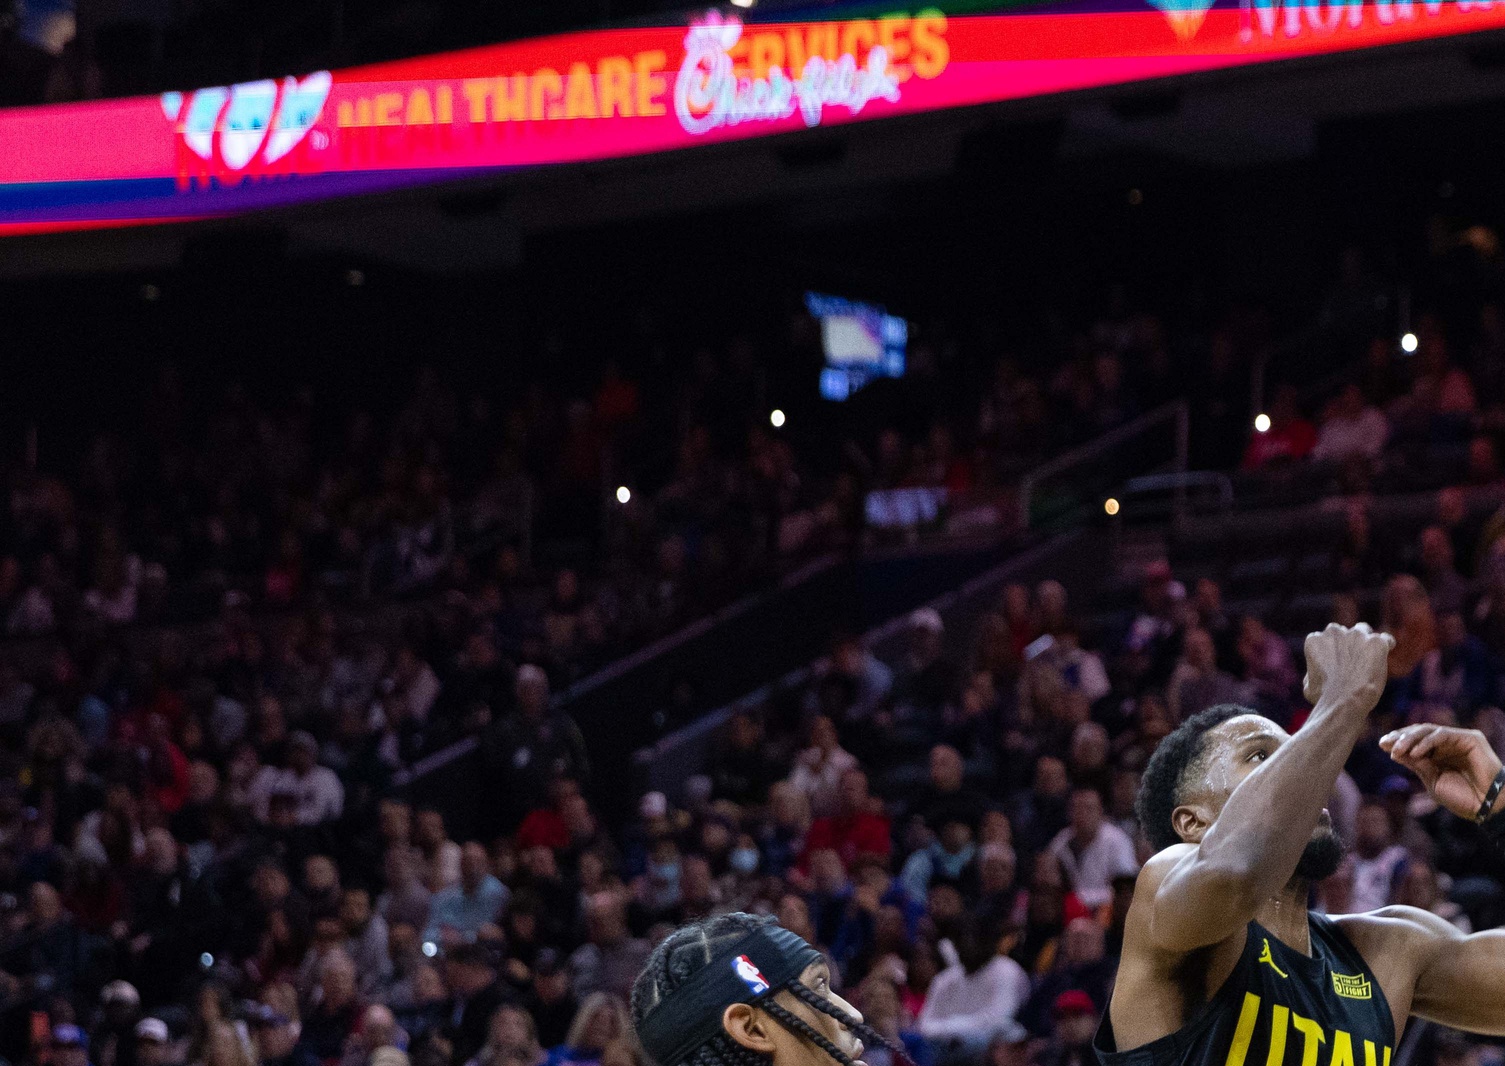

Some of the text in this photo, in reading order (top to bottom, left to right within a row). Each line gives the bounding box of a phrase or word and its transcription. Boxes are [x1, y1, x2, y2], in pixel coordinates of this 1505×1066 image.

[338, 50, 667, 165] HEALTHCARE
[1333, 976, 1342, 993] 5
[1345, 986, 1367, 996] FIGHT
